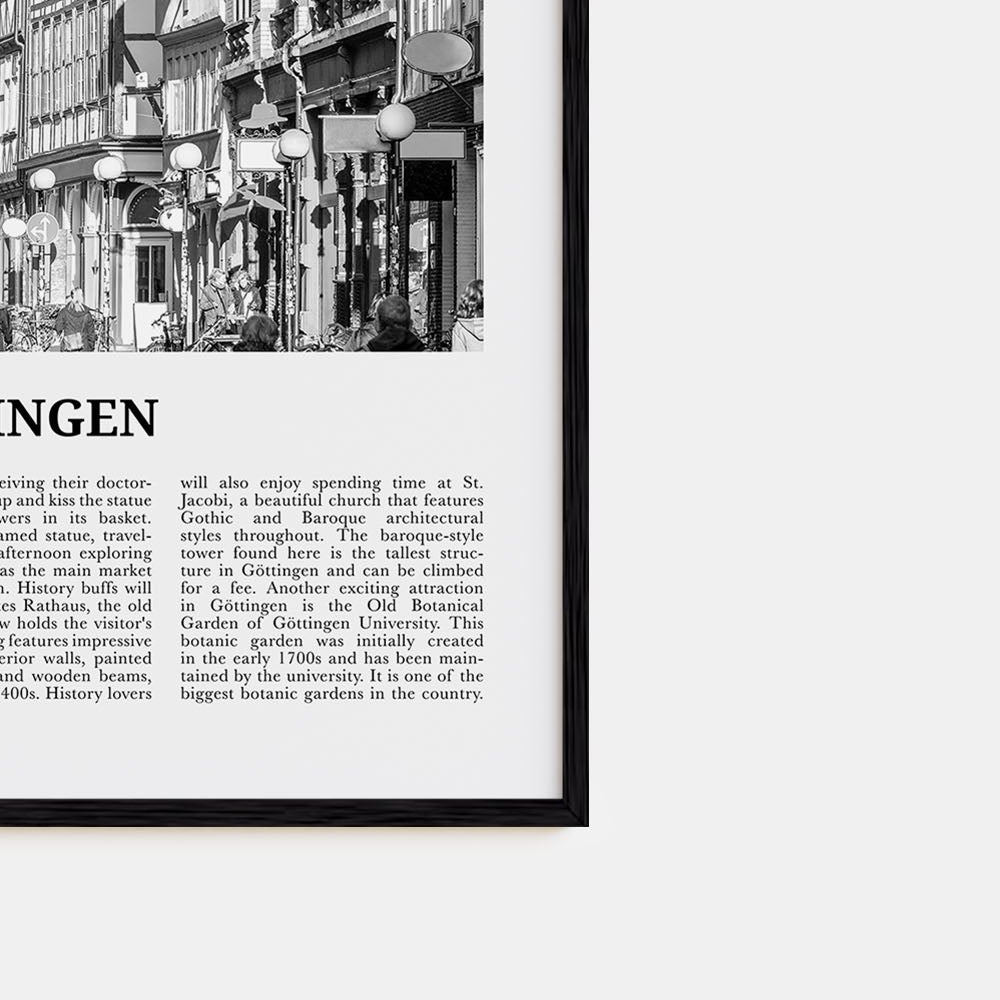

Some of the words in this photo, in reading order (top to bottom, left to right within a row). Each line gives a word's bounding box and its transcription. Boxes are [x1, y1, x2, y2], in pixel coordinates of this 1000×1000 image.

[52, 475, 89, 489] their
[96, 475, 152, 489] doctor-
[180, 475, 208, 489] will
[218, 475, 249, 489] also
[259, 475, 302, 493] enjoy
[312, 475, 382, 493] spending
[392, 475, 426, 489] time
[437, 478, 452, 489] at
[463, 475, 484, 489] St.
[15, 492, 45, 507] and
[48, 492, 76, 507] kiss
[79, 492, 104, 507] the
[106, 495, 152, 507] statue
[179, 492, 233, 511] Jacobi,
[239, 497, 249, 507] a
[254, 492, 323, 507] beautiful
[328, 492, 381, 507] church
[387, 492, 418, 507] that
[423, 492, 484, 507] features
[42, 510, 58, 525] in
[69, 510, 88, 525] its
[99, 510, 152, 525] basket.
[180, 510, 234, 525] Gothic
[252, 510, 282, 525] and
[301, 510, 367, 528] Baroque
[385, 510, 484, 525] architectural
[180, 528, 222, 546] styles
[233, 528, 324, 546] throughout.
[337, 528, 368, 542] The
[380, 528, 484, 546] baroque-style
[79, 545, 153, 564] exploring
[180, 566, 212, 577] ture
[218, 563, 234, 577] in
[241, 563, 319, 581] Göttingen
[326, 563, 356, 577] and
[362, 567, 390, 577] can
[397, 563, 416, 577] be
[422, 563, 484, 577] climbed
[17, 580, 75, 599] History
[81, 580, 119, 595] buffs
[124, 580, 152, 595] will
[23, 598, 91, 615] Rathaus,
[97, 598, 122, 612] the
[127, 598, 153, 612] old
[180, 598, 196, 612] in
[210, 598, 288, 616] Göttingen
[302, 598, 314, 612] is
[328, 598, 353, 612] the
[366, 598, 397, 612] Old
[411, 598, 484, 612] Botanical
[17, 616, 58, 630] holds
[63, 616, 88, 630] the
[93, 616, 153, 630] visitor's
[180, 616, 239, 630] Garden
[246, 616, 264, 630] of
[272, 616, 350, 634] Göttingen
[359, 616, 441, 634] University.
[450, 616, 485, 630] This
[8, 633, 70, 648] features
[72, 634, 152, 652] impressive
[180, 686, 235, 704] biggest
[240, 686, 298, 700] botanic
[304, 686, 364, 704] gardens
[370, 686, 385, 700] in
[391, 686, 416, 700] the
[421, 689, 484, 704] country.
